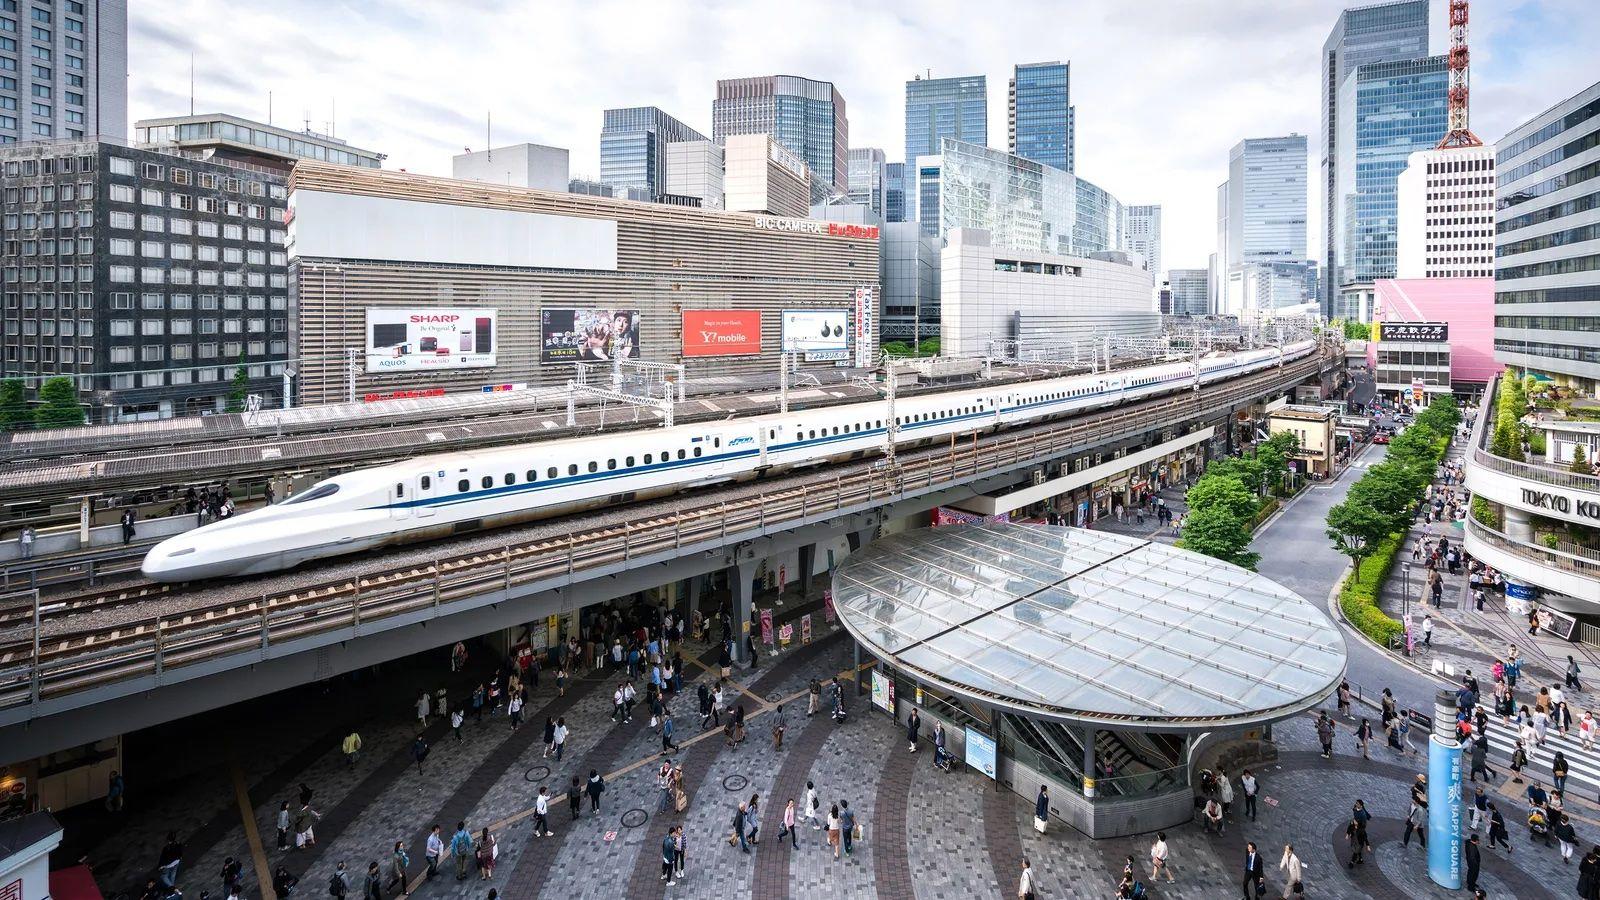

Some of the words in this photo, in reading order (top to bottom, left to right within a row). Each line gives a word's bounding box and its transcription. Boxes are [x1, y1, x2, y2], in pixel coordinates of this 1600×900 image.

[754, 217, 775, 229] BIC
[777, 219, 821, 233] CAMERA
[828, 223, 879, 238] ビックカメラ
[410, 315, 460, 323] SHARP
[379, 359, 407, 367] AQUOS
[1520, 488, 1570, 513] TOKYO
[1451, 805, 1459, 838] HAPPY
[1450, 840, 1459, 880] SQUARE
